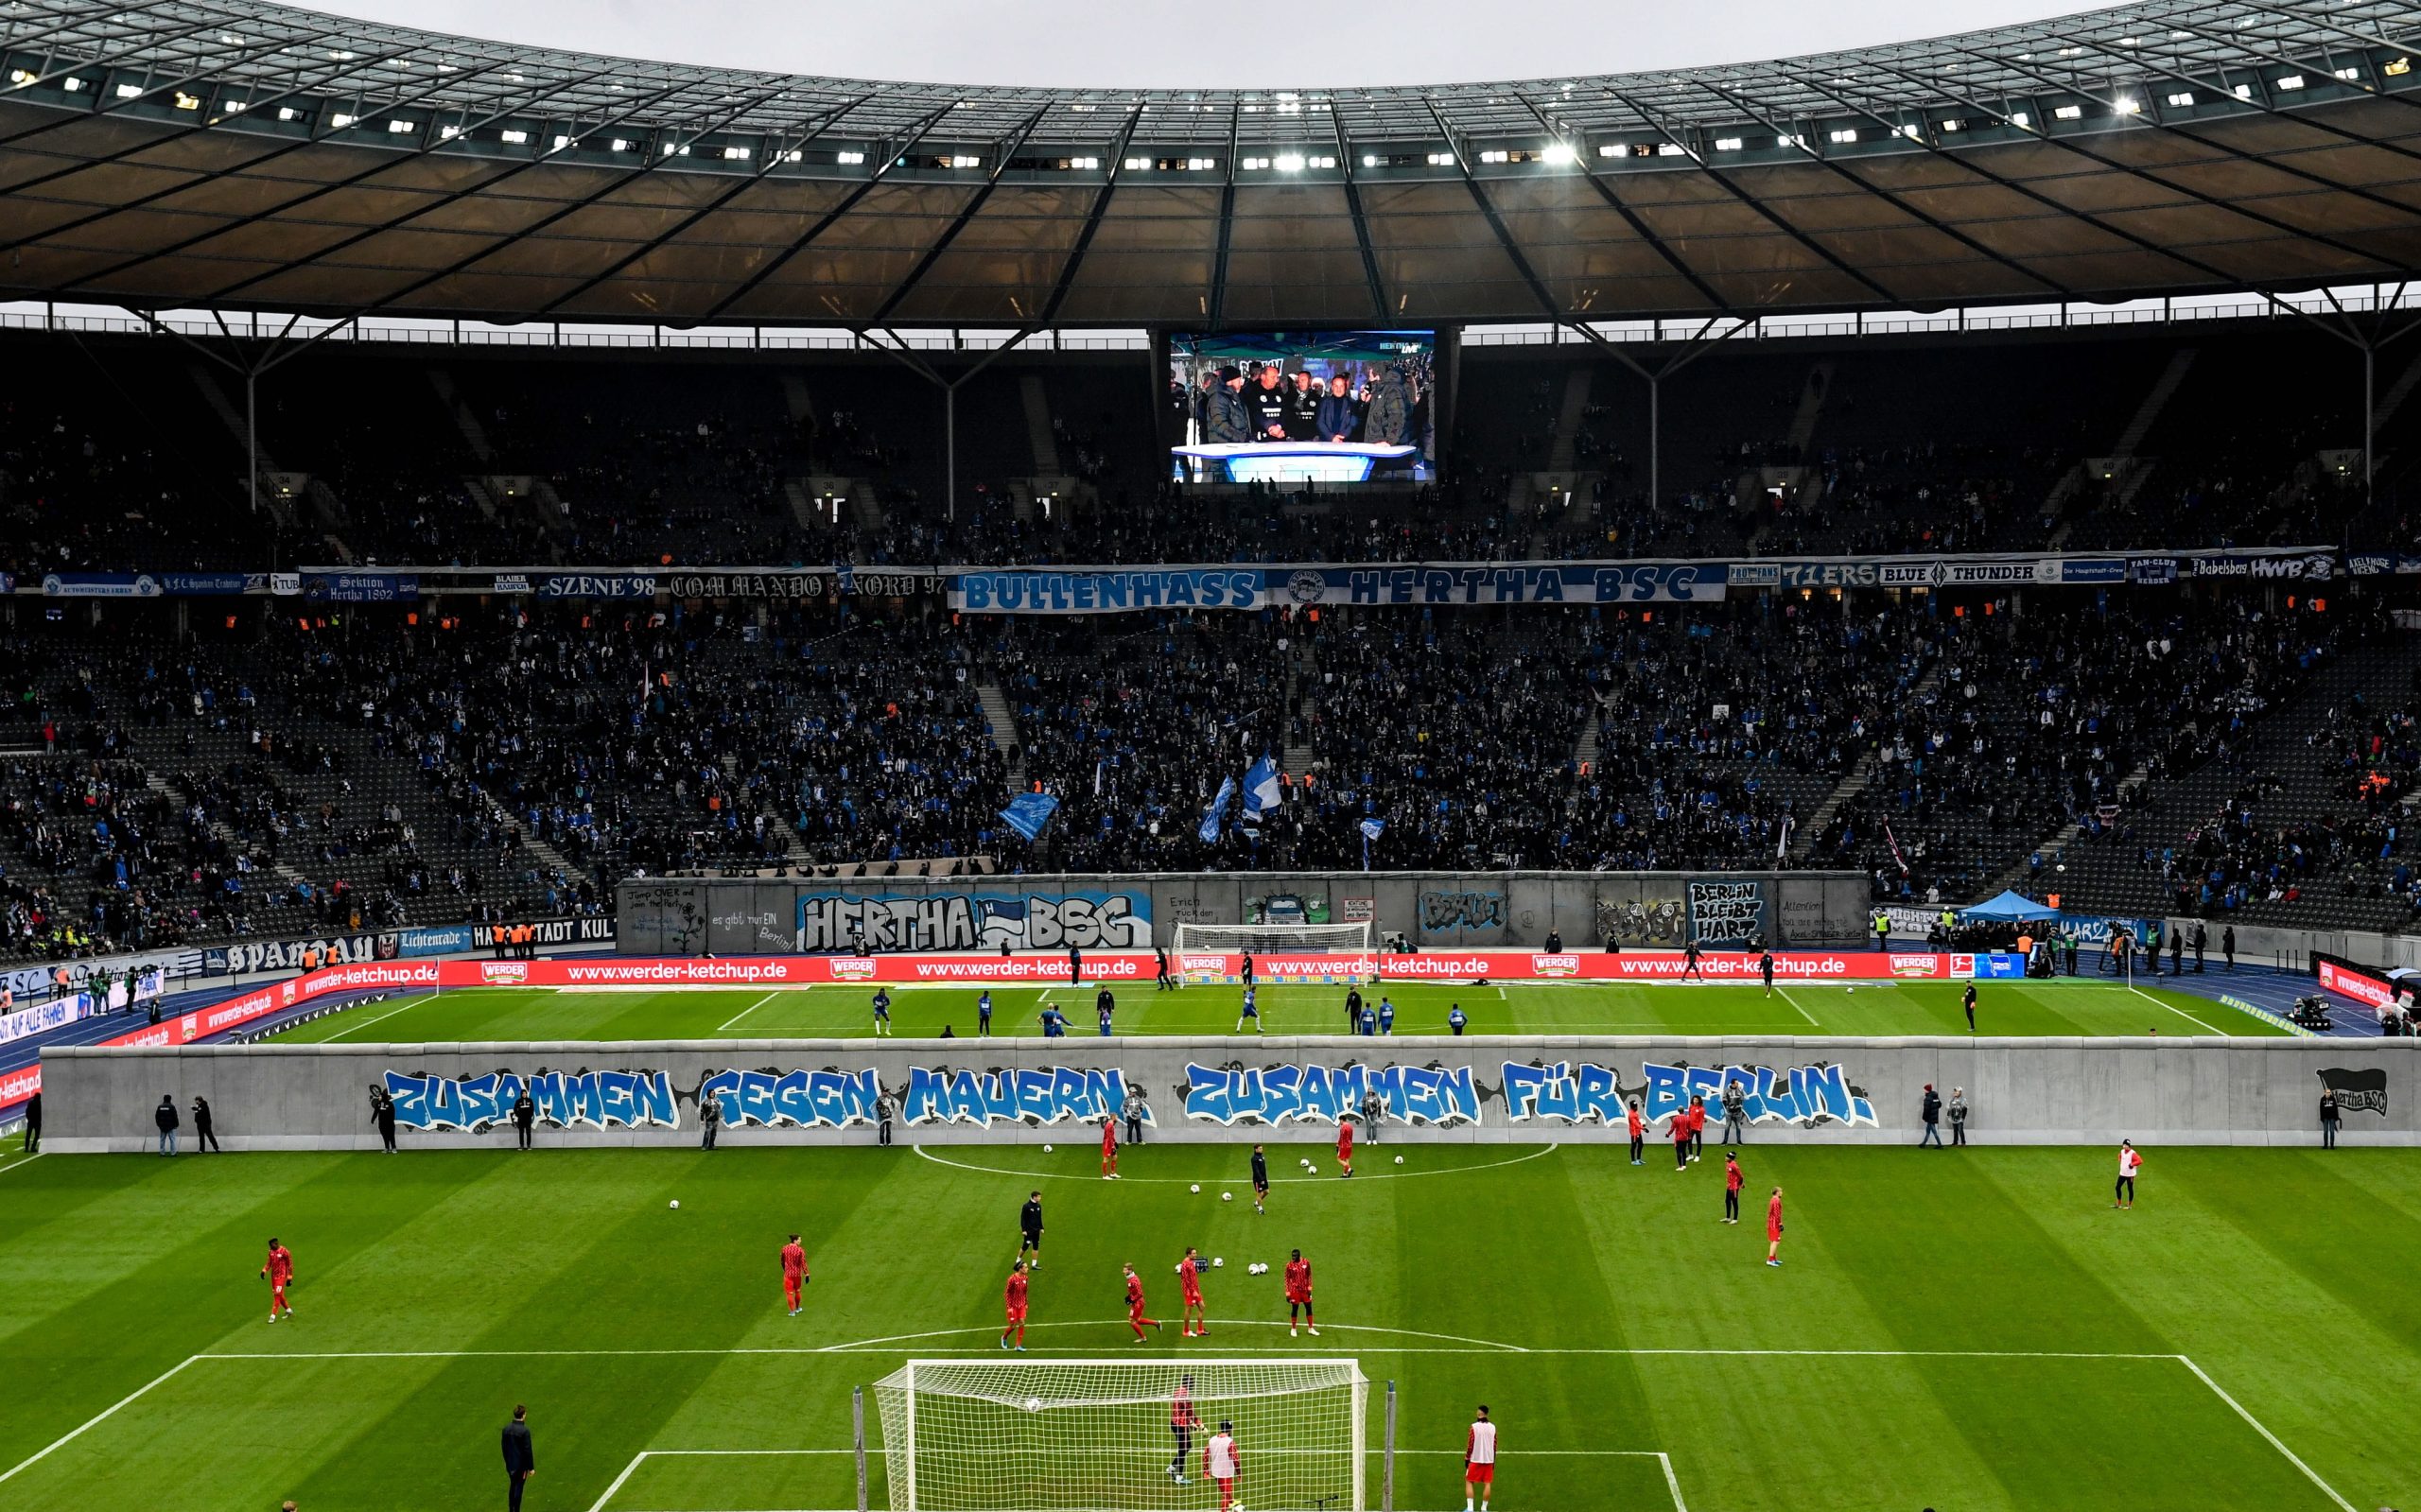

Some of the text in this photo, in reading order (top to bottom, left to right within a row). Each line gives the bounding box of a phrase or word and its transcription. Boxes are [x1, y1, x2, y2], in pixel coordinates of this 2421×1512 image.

[2131, 558, 2177, 567] FAN-CLUB
[2199, 560, 2248, 575] Babelsberg
[1758, 567, 1778, 577] FANS
[1781, 565, 1877, 586] 71ERS
[1884, 568, 1926, 582] BLUE
[1954, 566, 2034, 580] THUNDER
[281, 580, 299, 589] TUB
[339, 576, 384, 587] Sektion
[670, 576, 946, 597] COMMANDO NORD 97
[1350, 566, 1698, 604] HERTHA BSC
[331, 589, 393, 601] Hertha 1892
[963, 573, 1256, 610] BULLENHASS
[628, 891, 652, 900] Jump
[654, 889, 680, 897] OVER
[1170, 896, 1200, 907] Erich
[630, 898, 684, 910] join the Party
[1199, 908, 1213, 917] den
[712, 912, 777, 930] es gibt nur EIN
[803, 895, 975, 950] HERTHA
[1028, 895, 1134, 948] BSC
[1887, 908, 1940, 923] MIGHTY
[759, 927, 795, 951] Berlin!
[1697, 918, 1758, 943] HART
[401, 931, 461, 948] Lichtenrade
[227, 936, 374, 975] SPANDAU
[1535, 957, 1576, 969] WERDER
[1893, 957, 1935, 969] WERDER
[484, 965, 525, 977] WERDER
[567, 963, 787, 982] www.werder-ketchup.de
[834, 961, 874, 973] WERDER
[915, 959, 1136, 979] www.werder-ketchup.de
[1183, 958, 1224, 972] WERDER
[1267, 957, 1489, 978] www.werder-ketchup.de
[1620, 955, 1845, 976] www.wrder-kechup.de
[305, 965, 439, 993] www.werder-ketchup.de
[11, 1015, 24, 1036] AUF
[26, 1008, 41, 1032] ALLE
[43, 1001, 66, 1027] FAHNEN
[383, 1069, 681, 1132] ZUSAMMEN
[700, 1067, 881, 1129] GEGEN
[1185, 1061, 1483, 1128] ZUSAMMEN
[1501, 1060, 1629, 1127] FÜR
[2332, 1090, 2385, 1109] Hertha BSC
